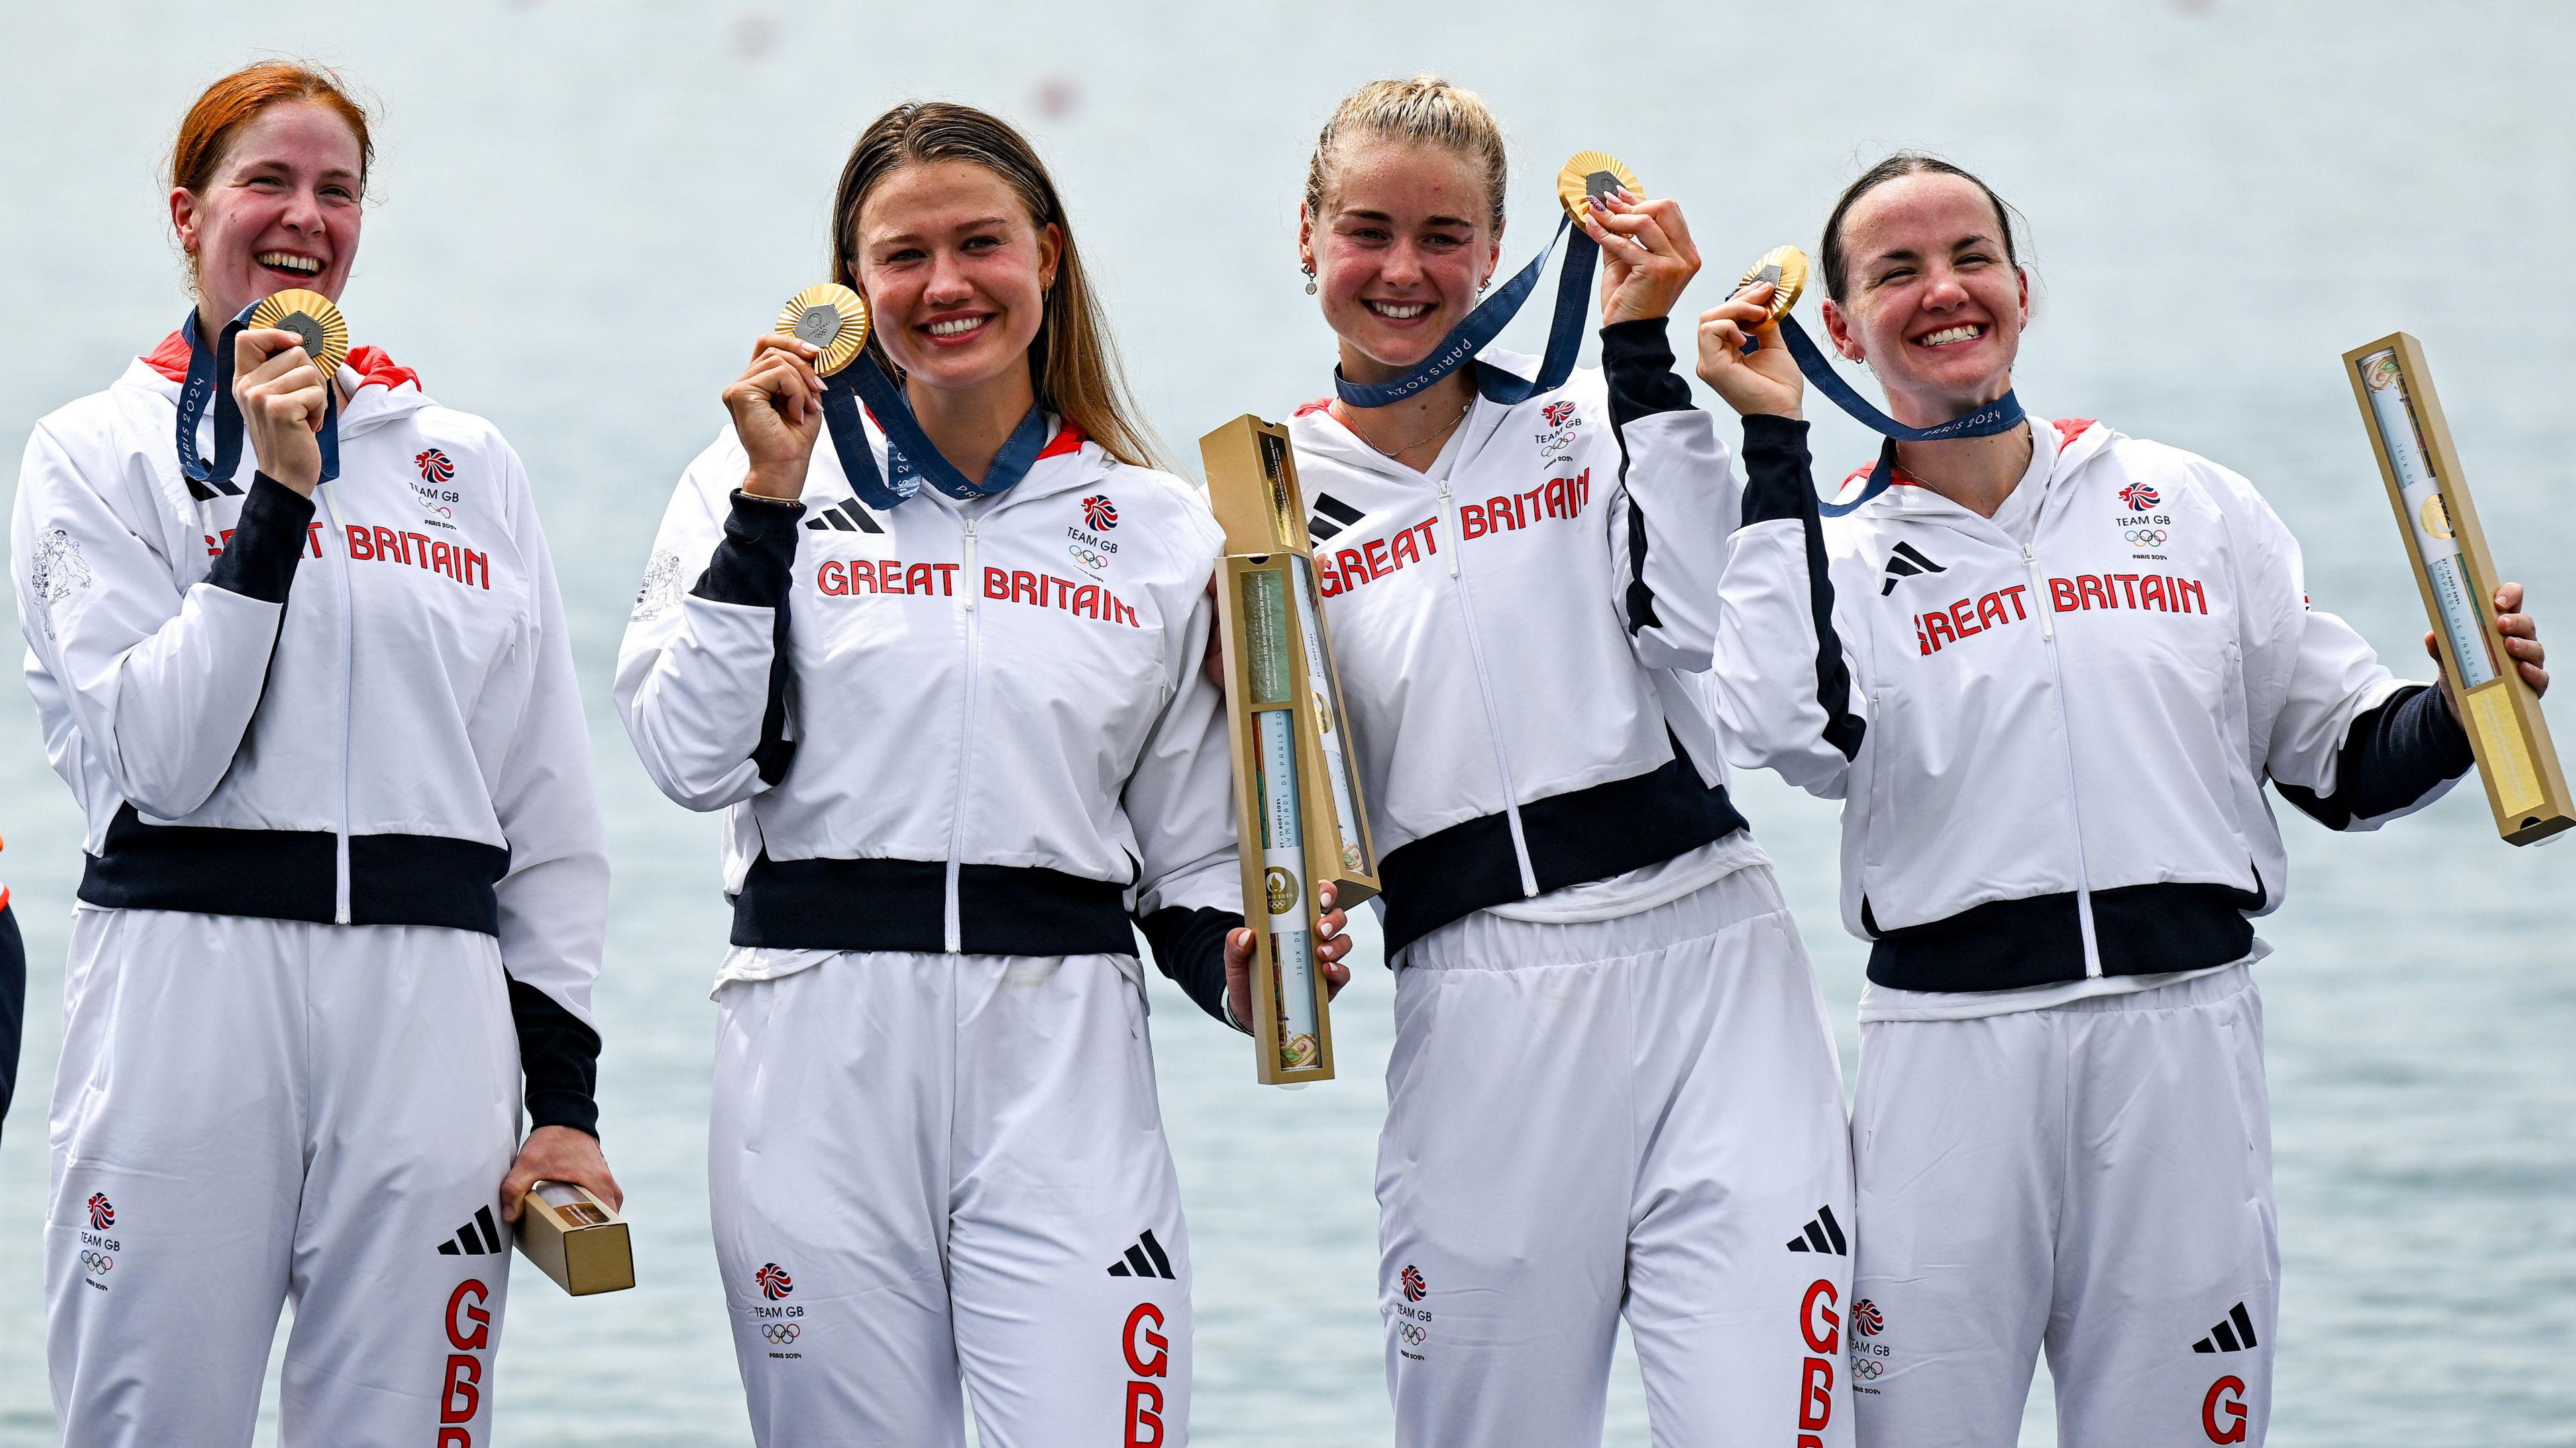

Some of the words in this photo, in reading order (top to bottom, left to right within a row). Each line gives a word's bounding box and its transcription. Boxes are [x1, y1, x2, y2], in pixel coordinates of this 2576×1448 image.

[1386, 375, 1428, 396] 2024
[183, 377, 205, 423] 2024
[1534, 427, 1563, 444] TEAM
[1565, 418, 1582, 429] GB
[1921, 422, 1964, 437] PARIS
[1967, 409, 2000, 429] 2024
[409, 482, 437, 500] TEAM
[441, 491, 460, 503] GB
[1460, 467, 1590, 541] BRITAIN
[425, 519, 441, 527] PARIS
[2116, 516, 2150, 526] TEAM
[2153, 515, 2171, 525] GB
[1067, 526, 1098, 547] TEAM
[1100, 540, 1118, 554] GB
[345, 524, 490, 590] BRITAIN
[817, 559, 960, 597] GREAT
[983, 566, 1140, 628] BRITAIN
[2048, 573, 2208, 615] BRITAIN
[1277, 734, 1285, 766] PARIS
[1281, 774, 1287, 785] DE
[1282, 793, 1293, 848] LYMPIADE
[1295, 950, 1303, 976] JEUX
[80, 1231, 101, 1248] TEAM
[104, 1239, 121, 1252] GB
[754, 1306, 783, 1318] TEAM
[786, 1306, 804, 1317] GB
[1397, 1302, 1415, 1319] TEAM
[1417, 1311, 1432, 1323] GB
[1797, 1278, 1840, 1448] GB
[1873, 1345, 1890, 1357] GB
